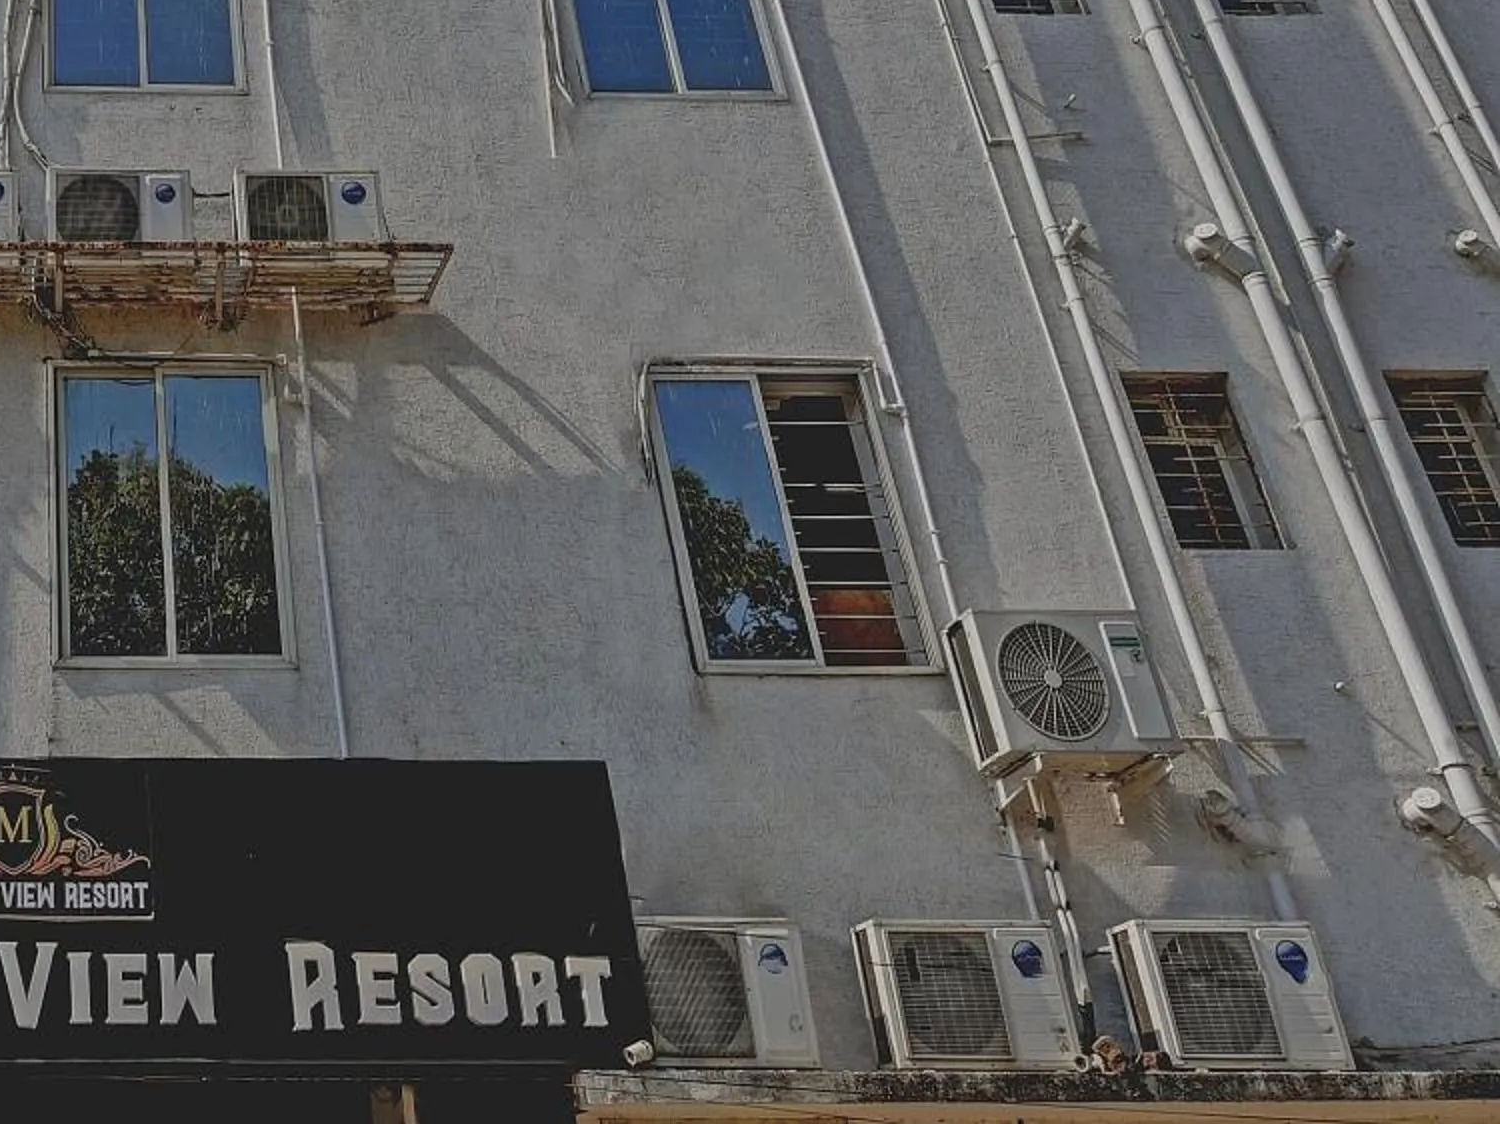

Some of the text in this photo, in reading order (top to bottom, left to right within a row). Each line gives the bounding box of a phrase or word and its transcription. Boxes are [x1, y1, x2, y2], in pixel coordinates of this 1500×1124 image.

[0, 881, 56, 909] VIEW
[64, 881, 150, 909] RESORT
[283, 940, 612, 1032] RESORT
